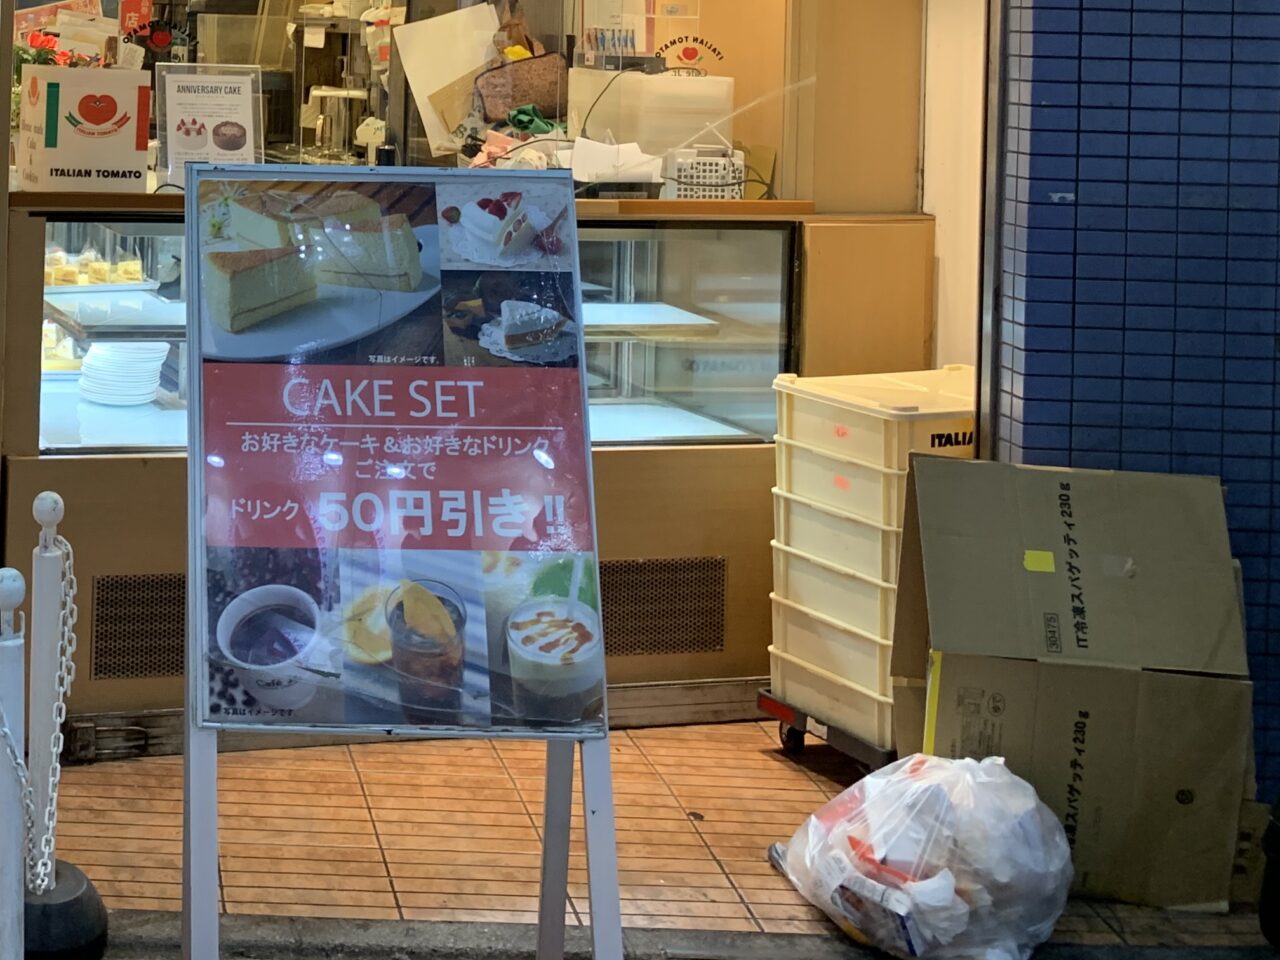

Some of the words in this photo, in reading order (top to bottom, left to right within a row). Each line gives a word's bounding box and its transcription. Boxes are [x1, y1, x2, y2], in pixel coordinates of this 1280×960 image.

[176, 85, 223, 95] ANNIVERSARY
[224, 86, 242, 95] CAKE
[50, 168, 92, 178] ITALIAN
[96, 170, 142, 179] TOMATO
[283, 378, 396, 419] CAKE
[409, 380, 484, 419] SET
[230, 498, 300, 521] ドリンク
